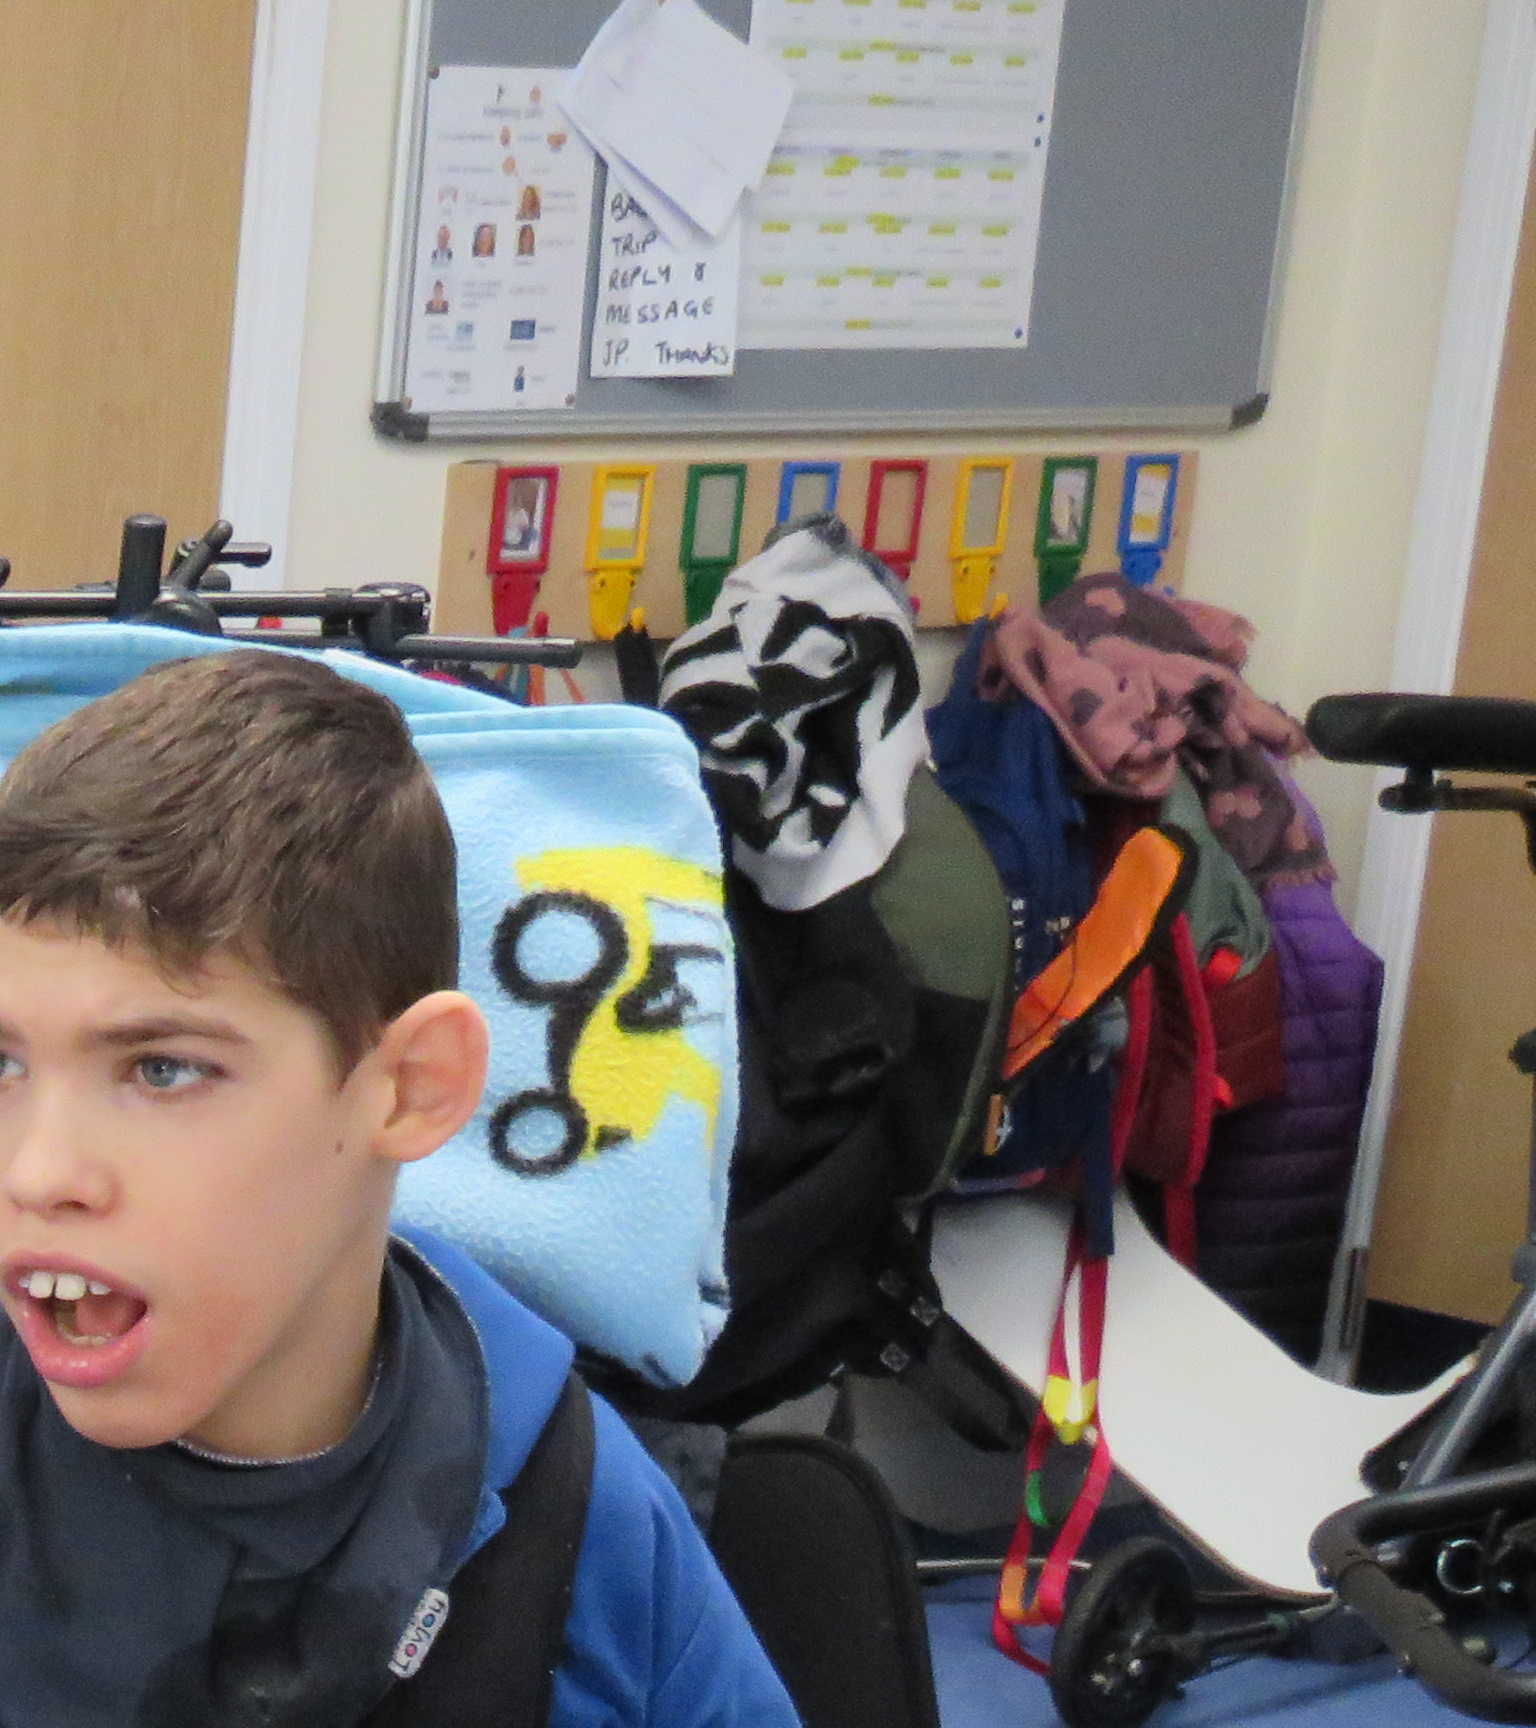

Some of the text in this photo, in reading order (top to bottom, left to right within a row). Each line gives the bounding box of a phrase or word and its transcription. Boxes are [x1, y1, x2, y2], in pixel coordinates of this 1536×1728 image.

[612, 230, 658, 256] TRIP
[609, 265, 671, 291] REPLY
[605, 296, 714, 323] MESSAGE
